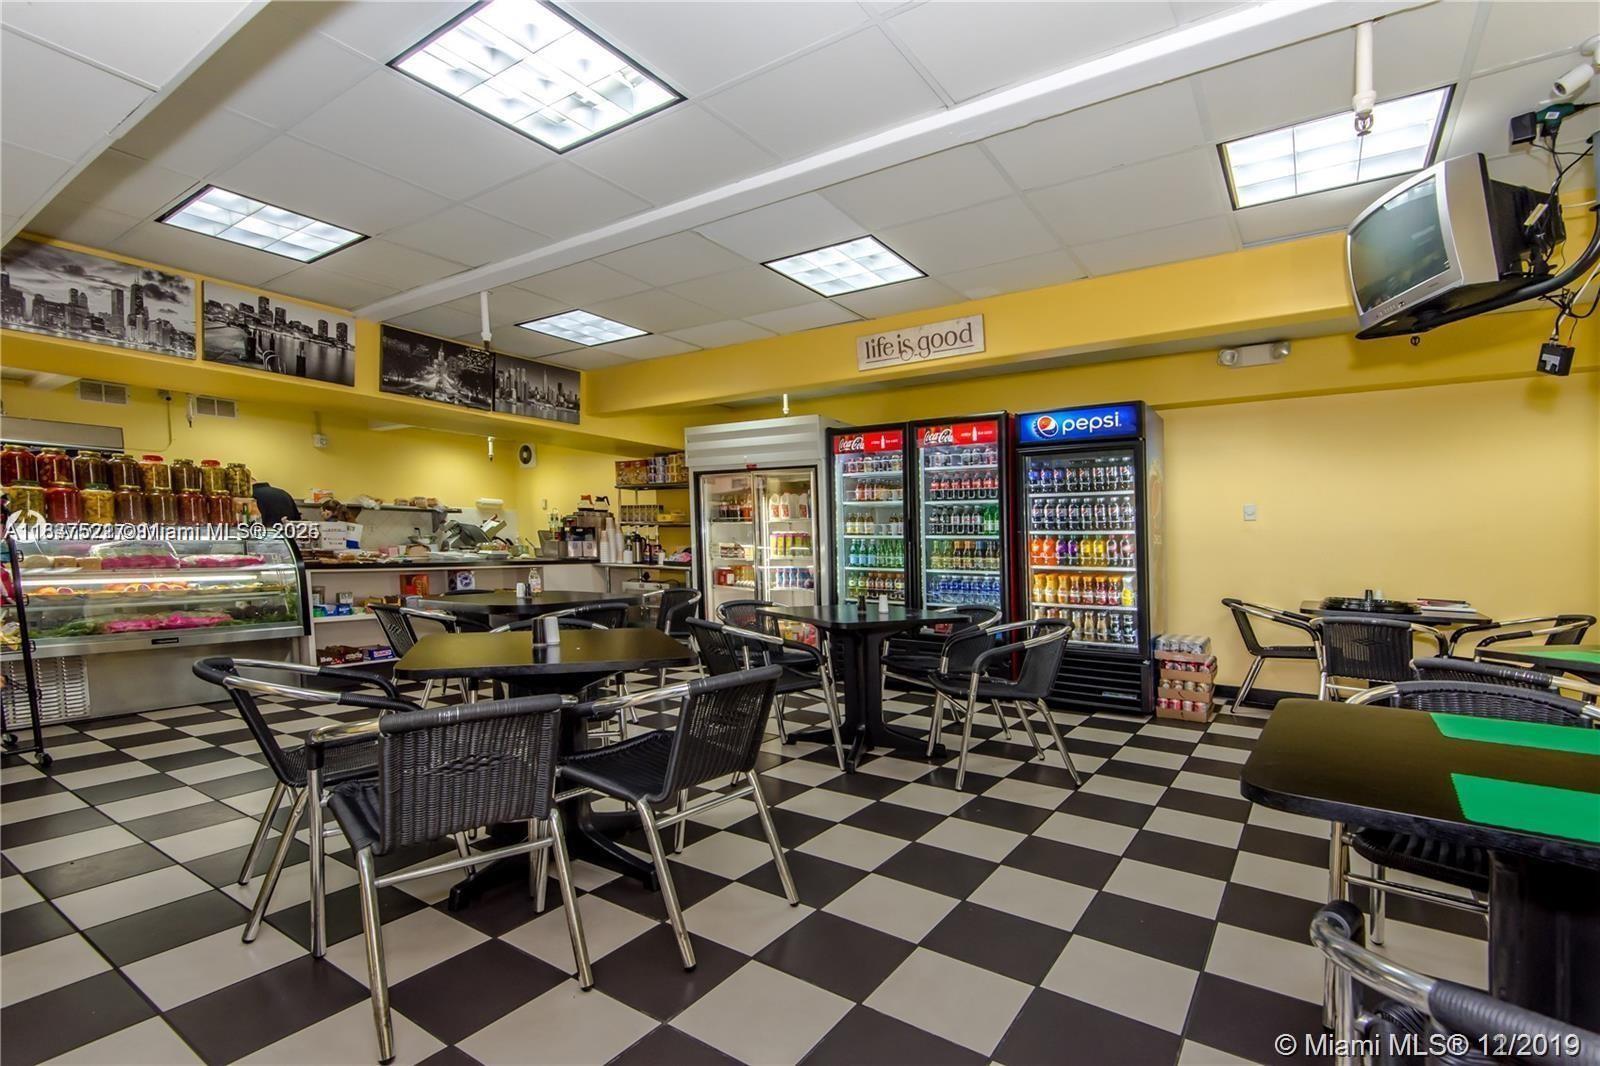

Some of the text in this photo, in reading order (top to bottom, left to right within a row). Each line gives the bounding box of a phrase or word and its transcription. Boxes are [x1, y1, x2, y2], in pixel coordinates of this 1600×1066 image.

[865, 322, 973, 361] life is good
[1062, 411, 1119, 435] pepsi
